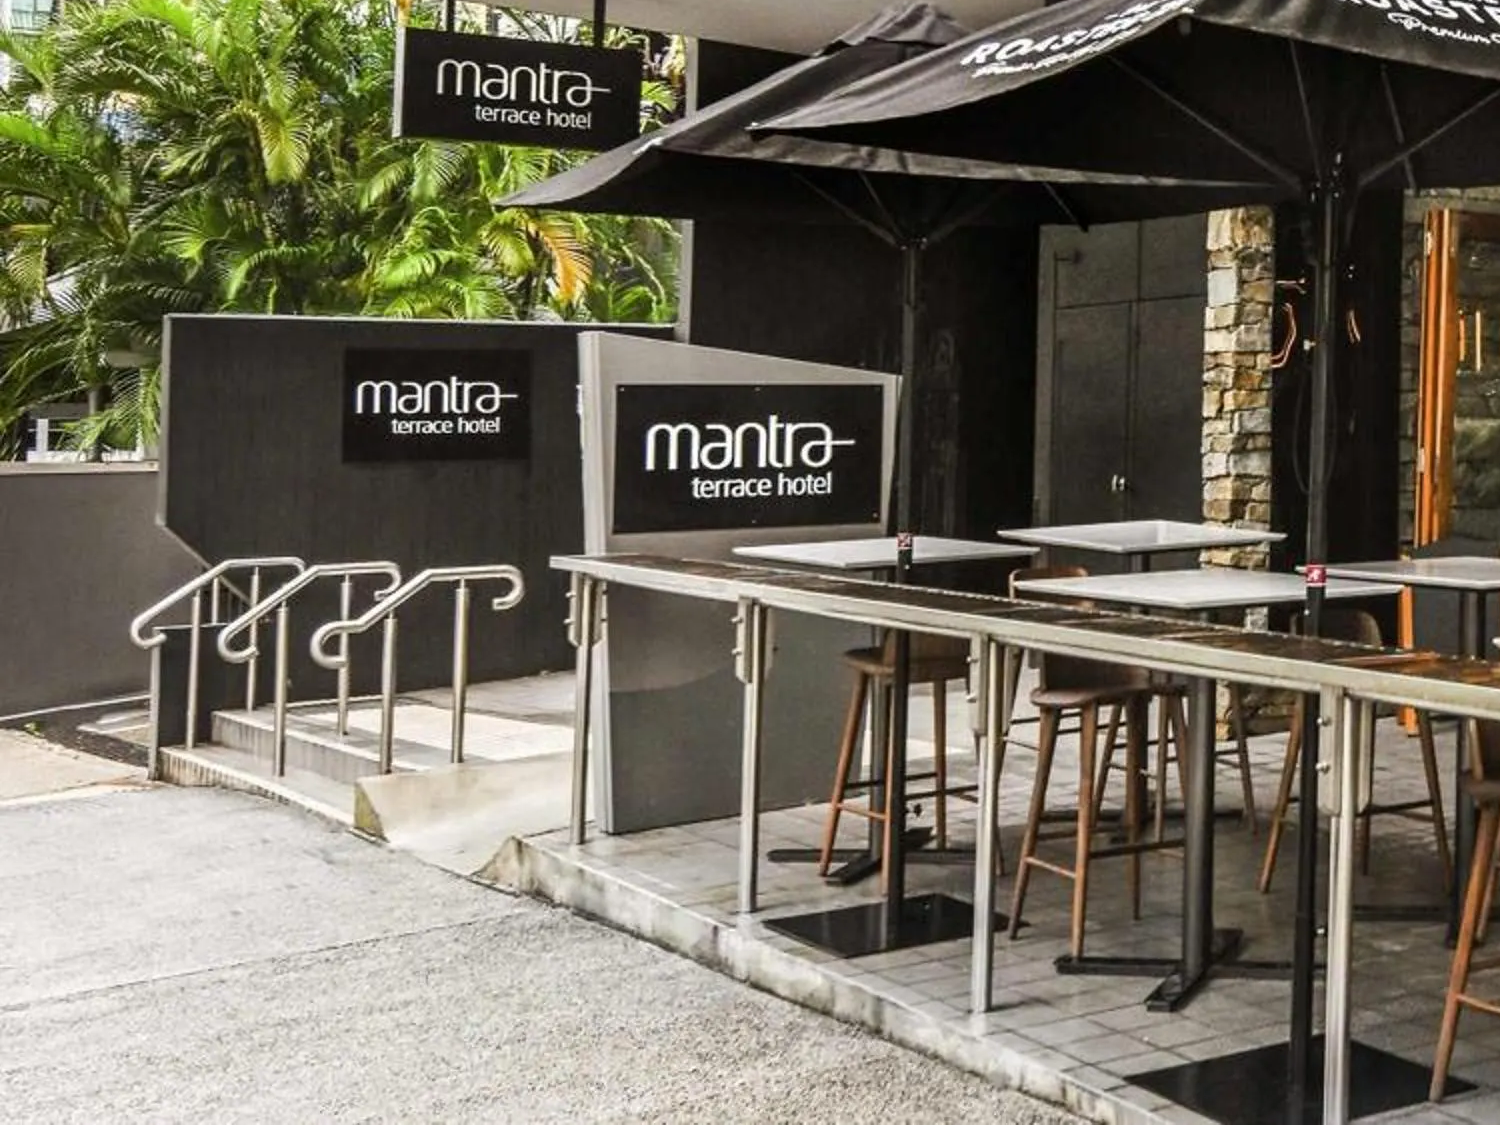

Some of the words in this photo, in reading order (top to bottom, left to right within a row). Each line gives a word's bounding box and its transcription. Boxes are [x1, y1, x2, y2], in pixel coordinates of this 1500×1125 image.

[1387, 12, 1491, 44] Premium
[436, 58, 610, 108] mantra
[475, 106, 541, 127] terrace
[546, 106, 592, 129] hotel
[355, 376, 518, 415] mantra
[391, 418, 453, 434] terrace
[456, 416, 501, 434] hotel
[645, 414, 856, 471] mantra
[691, 477, 772, 499] terrace
[777, 471, 832, 496] hotel
